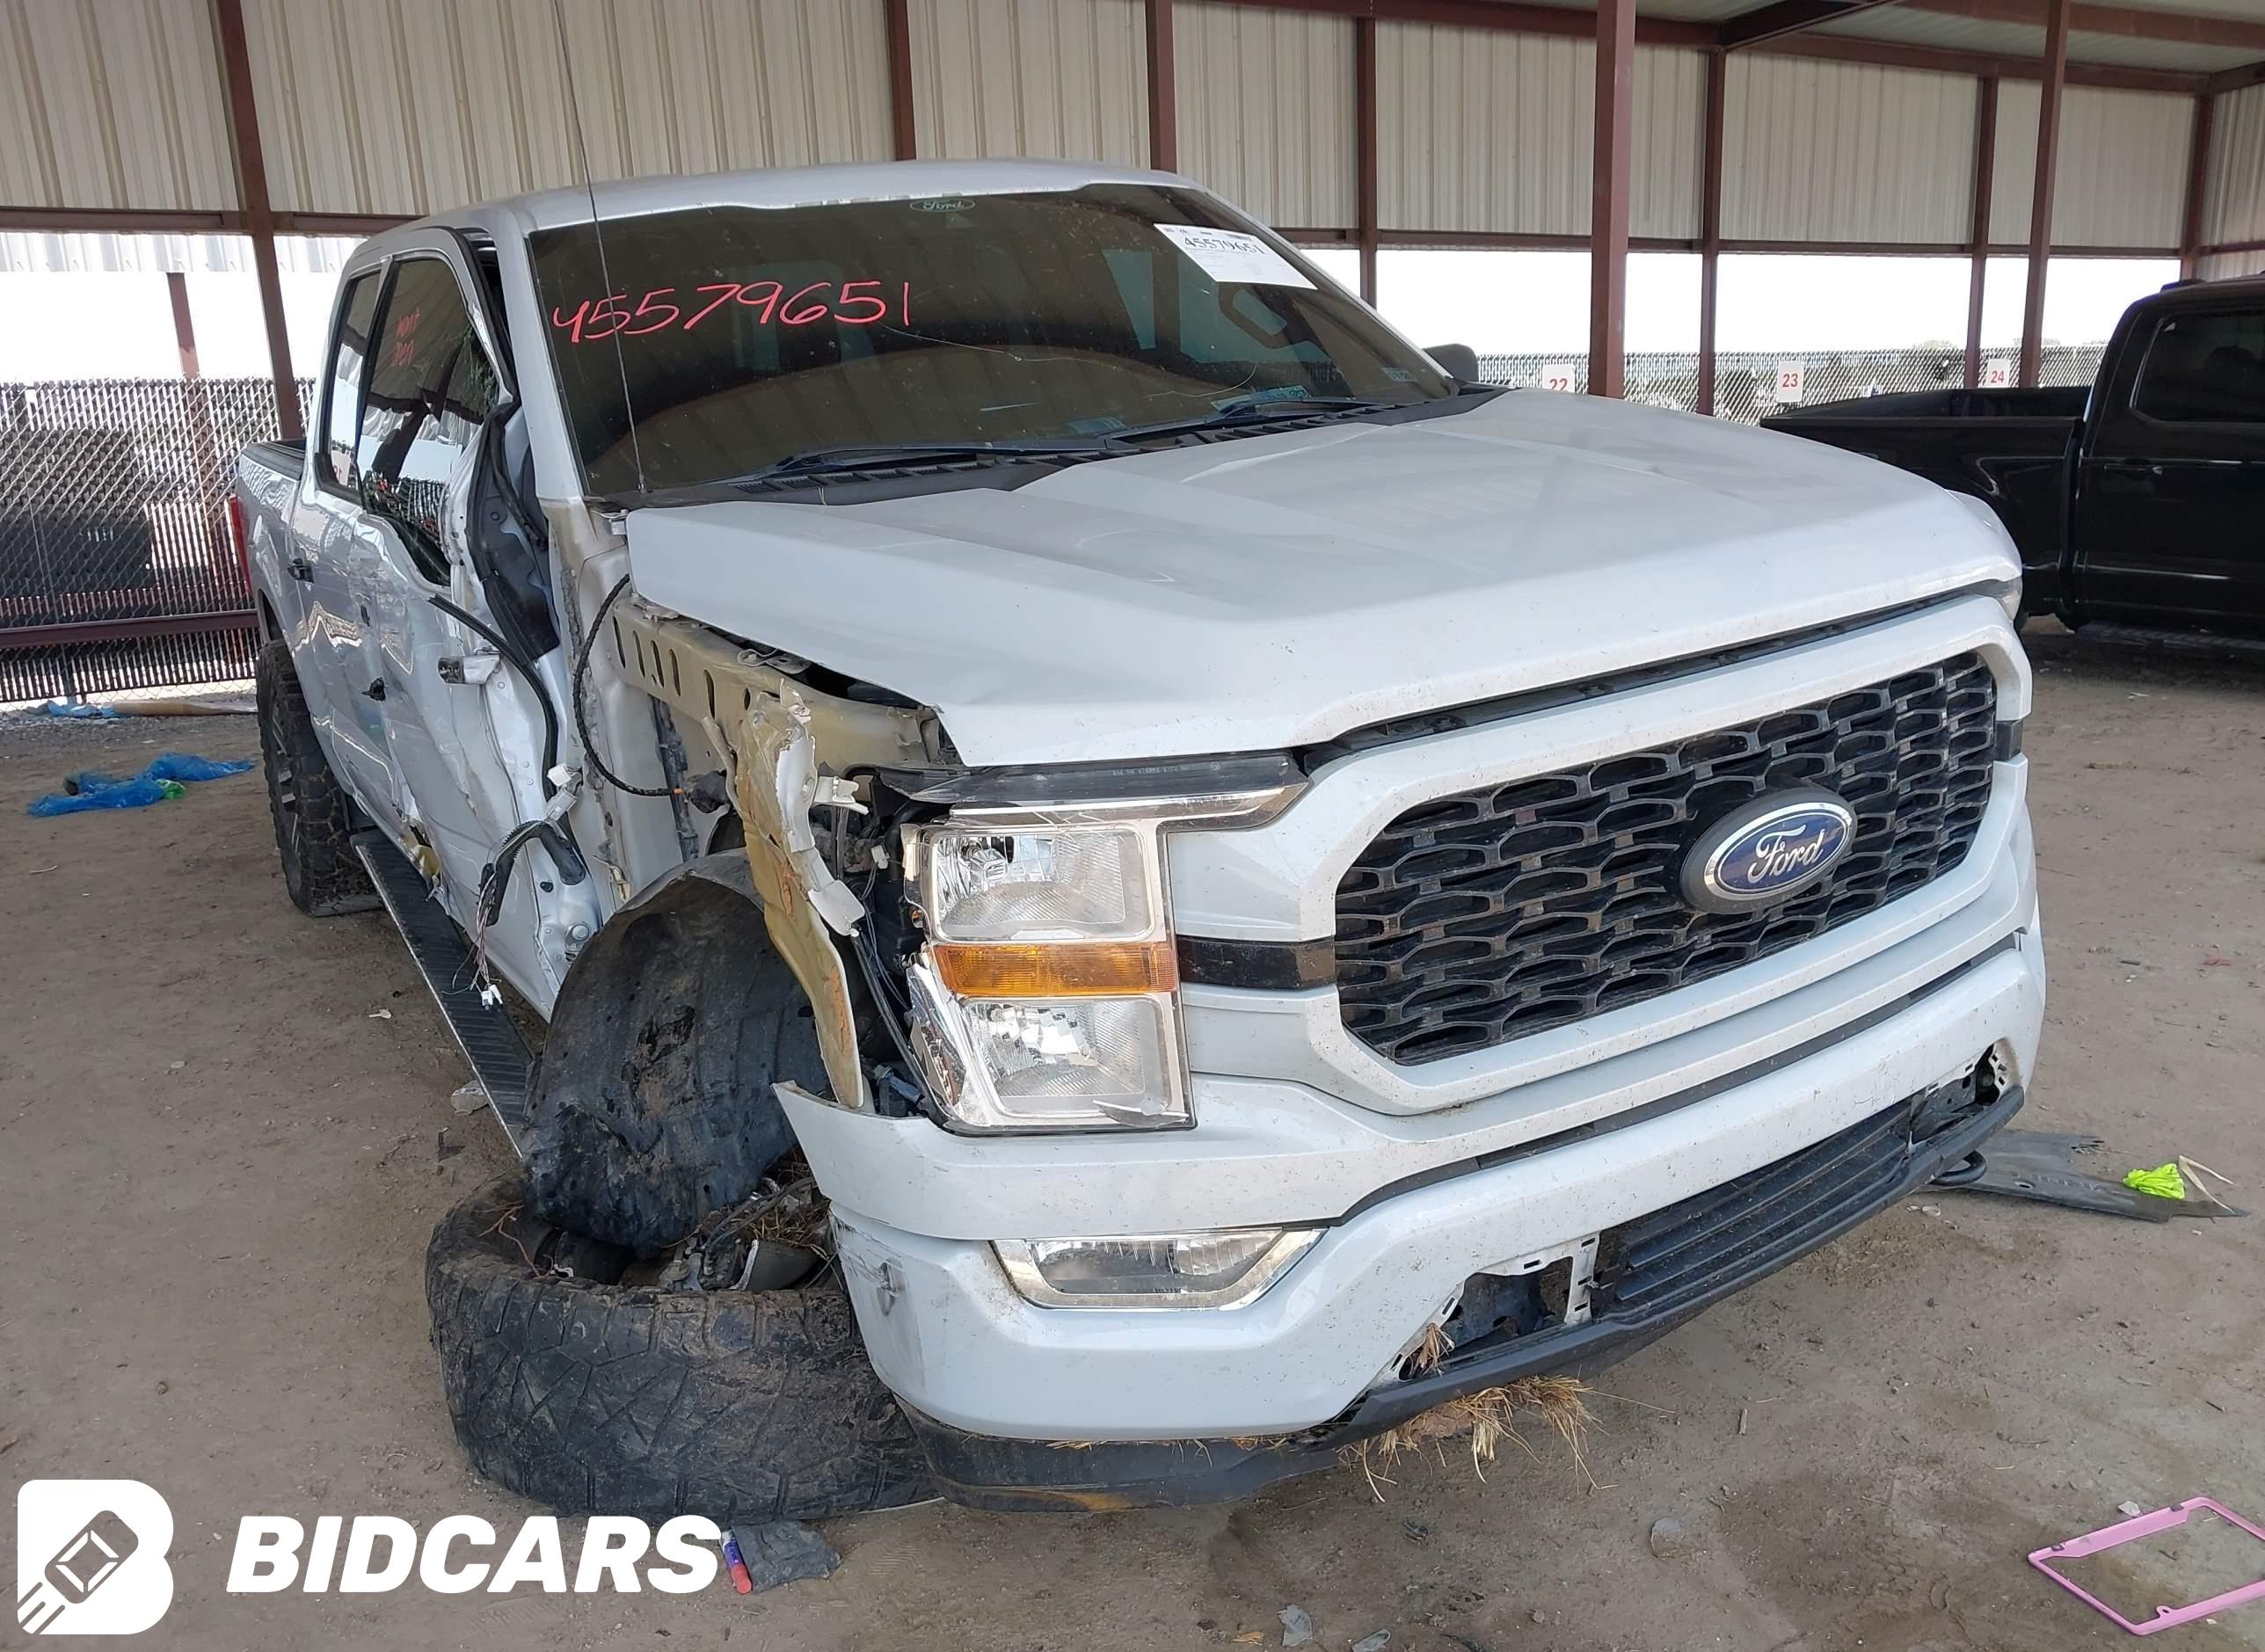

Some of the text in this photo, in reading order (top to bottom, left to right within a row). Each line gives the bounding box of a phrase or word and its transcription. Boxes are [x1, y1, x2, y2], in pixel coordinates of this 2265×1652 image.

[922, 200, 965, 210] Ford
[1183, 237, 1265, 254] 45579651
[552, 280, 910, 344] 45579651
[1782, 373, 1799, 388] 23
[1990, 370, 2005, 383] 24
[1747, 825, 1825, 884] Ford
